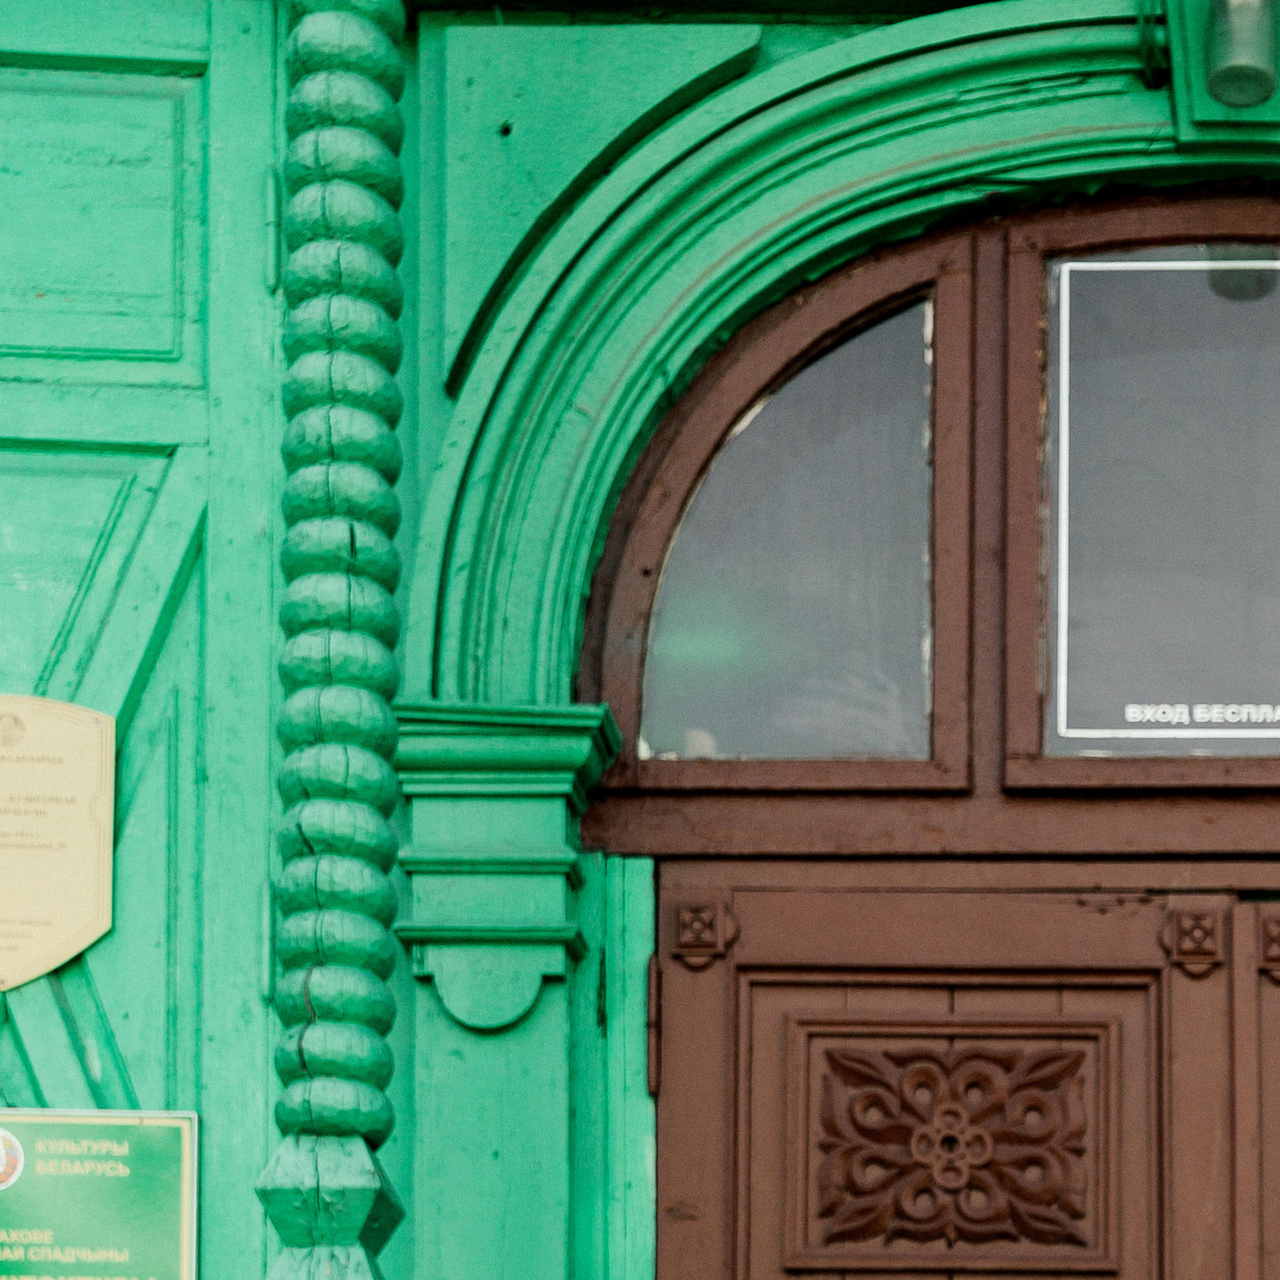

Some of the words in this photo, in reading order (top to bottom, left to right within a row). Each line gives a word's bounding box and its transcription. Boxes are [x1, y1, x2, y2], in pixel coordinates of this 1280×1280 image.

[1125, 703, 1190, 725] ВХОД
[35, 1138, 129, 1156] КУЛЬТУРЫ
[35, 1159, 130, 1177] БЕЛАРУСЬ
